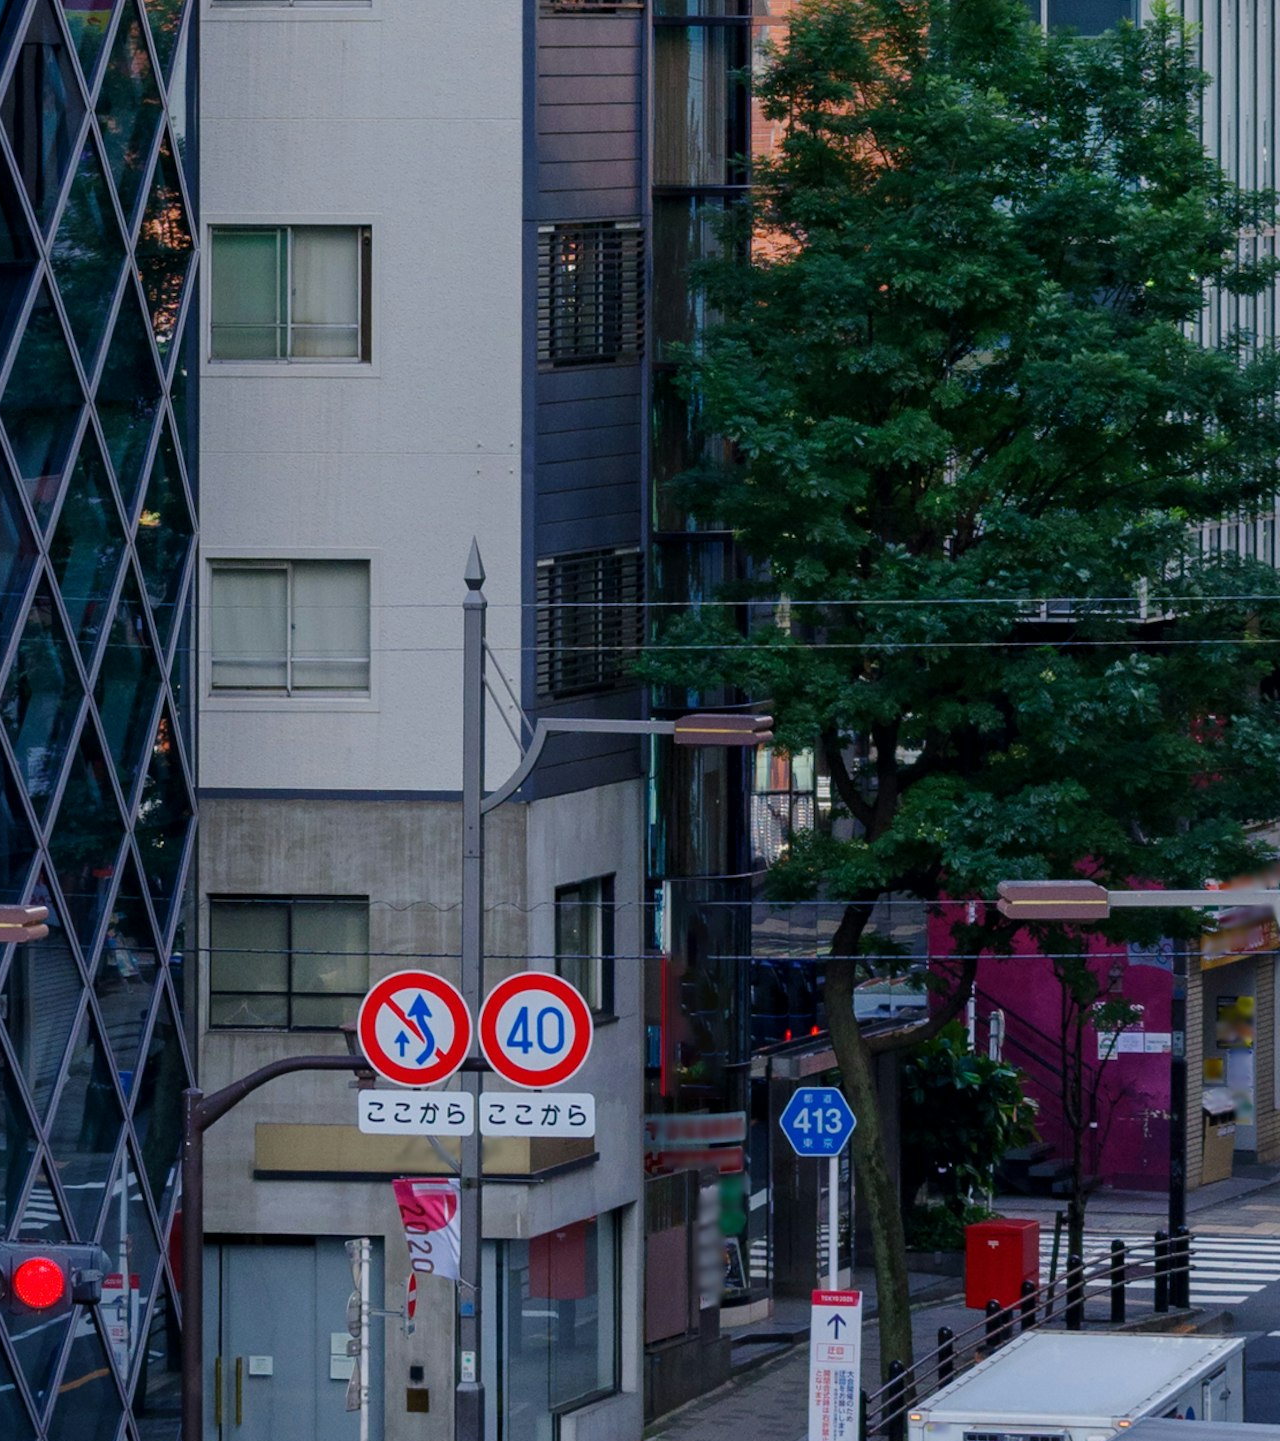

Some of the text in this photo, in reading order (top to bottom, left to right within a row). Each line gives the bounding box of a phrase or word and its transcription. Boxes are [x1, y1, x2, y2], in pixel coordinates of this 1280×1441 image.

[506, 1006, 565, 1055] 40
[367, 1101, 465, 1125] ここから
[488, 1103, 587, 1126] ここから
[793, 1107, 842, 1134] 413
[400, 1202, 434, 1274] 2020
